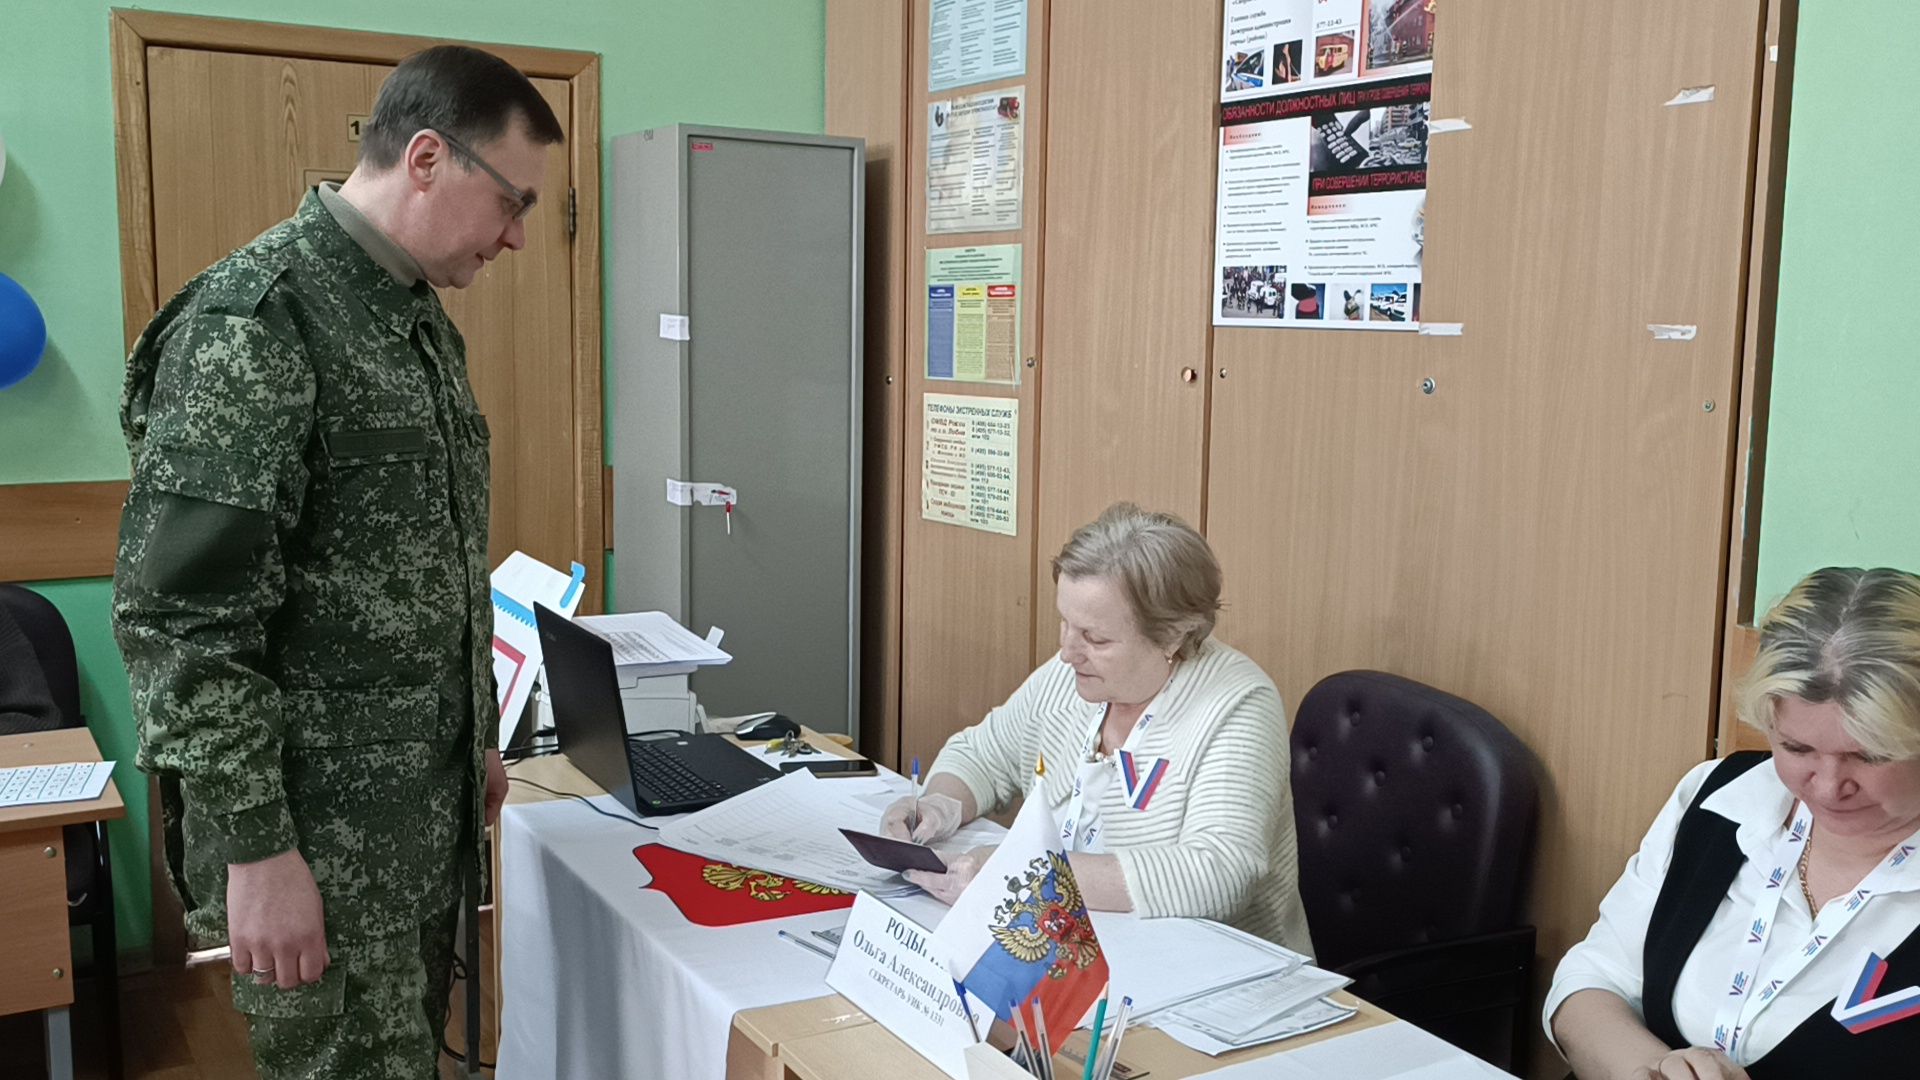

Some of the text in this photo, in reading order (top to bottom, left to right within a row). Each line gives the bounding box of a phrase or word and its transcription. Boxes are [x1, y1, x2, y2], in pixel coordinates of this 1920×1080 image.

[927, 403, 1012, 419] ТЕЛЕФОНЫ ЭКСТРЕННЫХ СЛУЖБ
[853, 929, 887, 964] Ольга
[868, 967, 906, 1000] СЕКРЕТАРЬ
[904, 992, 921, 1011] УИК
